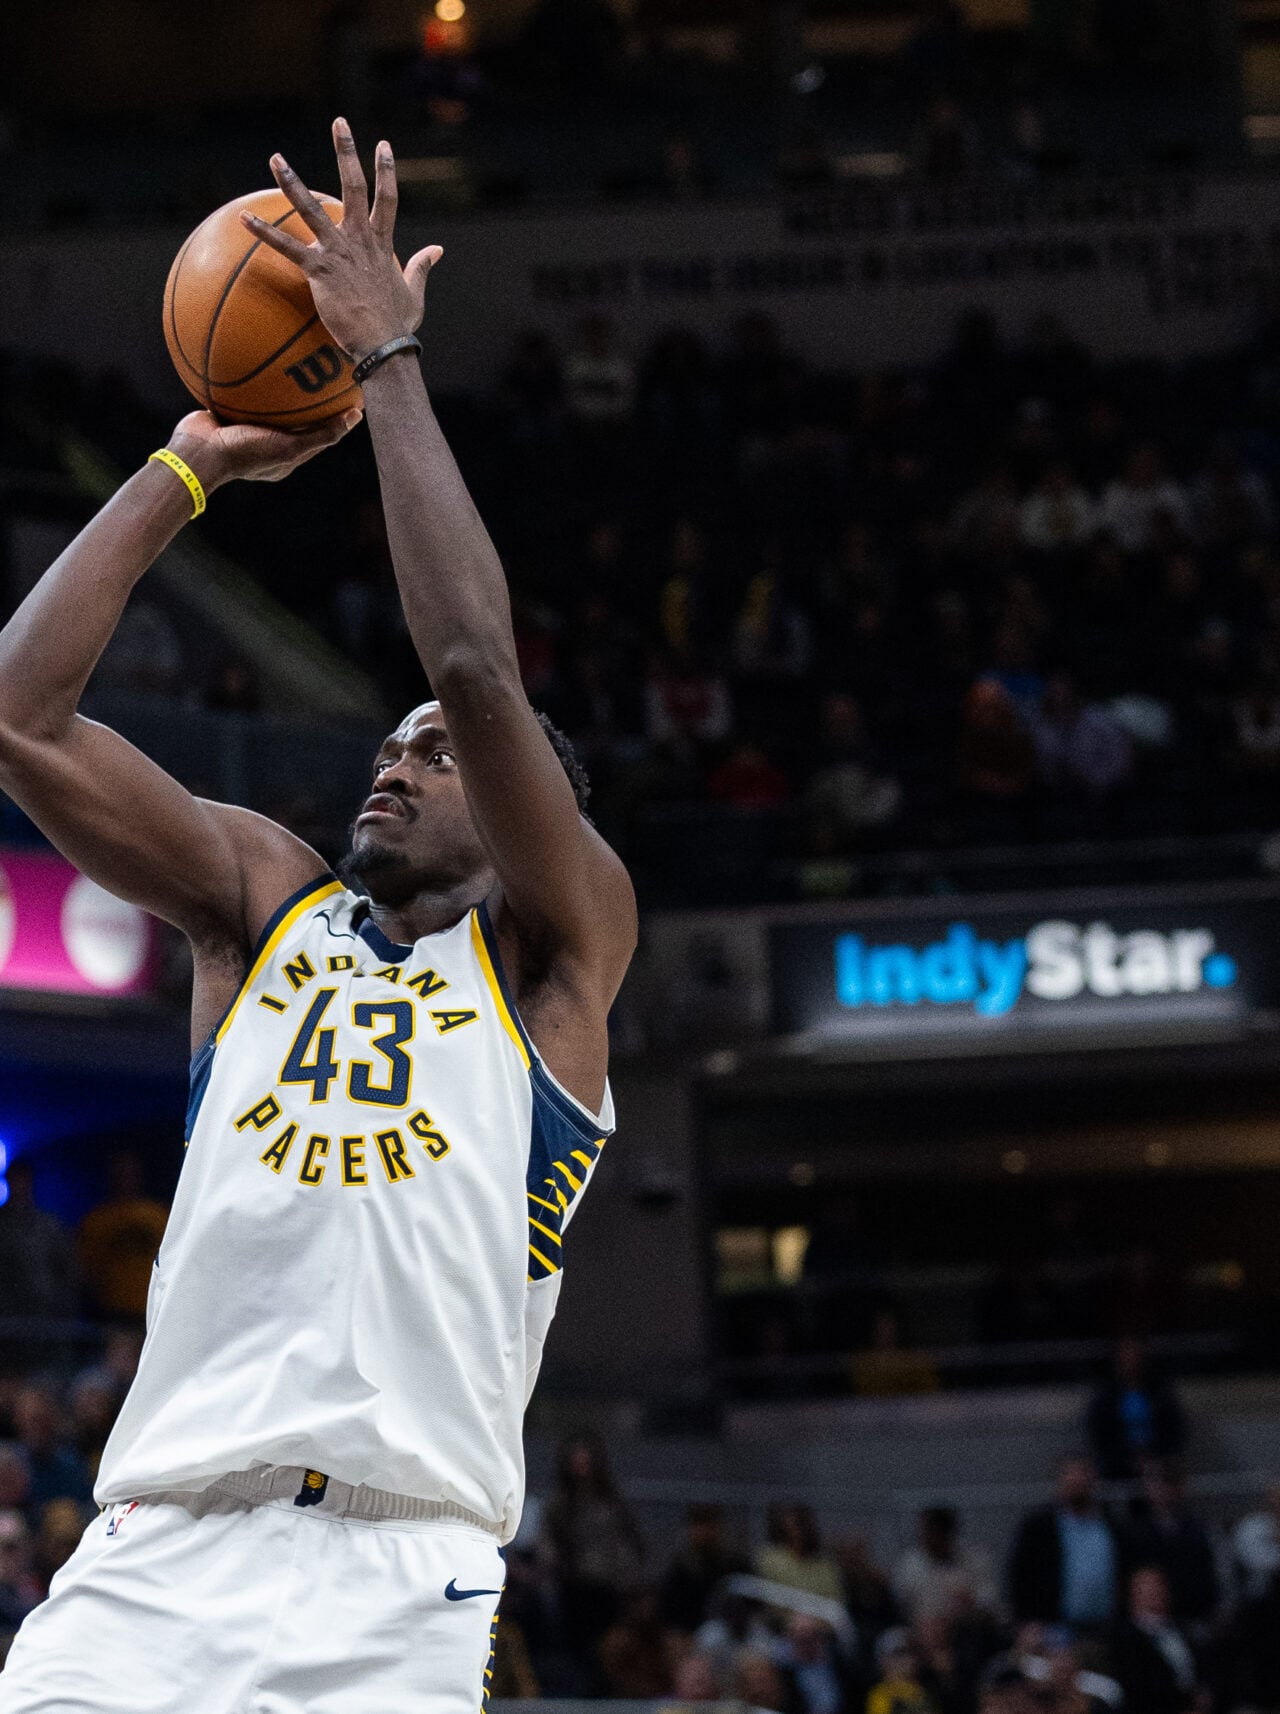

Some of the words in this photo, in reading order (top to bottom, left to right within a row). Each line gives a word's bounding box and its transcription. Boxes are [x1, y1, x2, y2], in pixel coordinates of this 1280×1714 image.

[257, 950, 500, 1036] INDANA
[277, 986, 416, 1109] 43
[233, 1091, 451, 1187] PACERS
